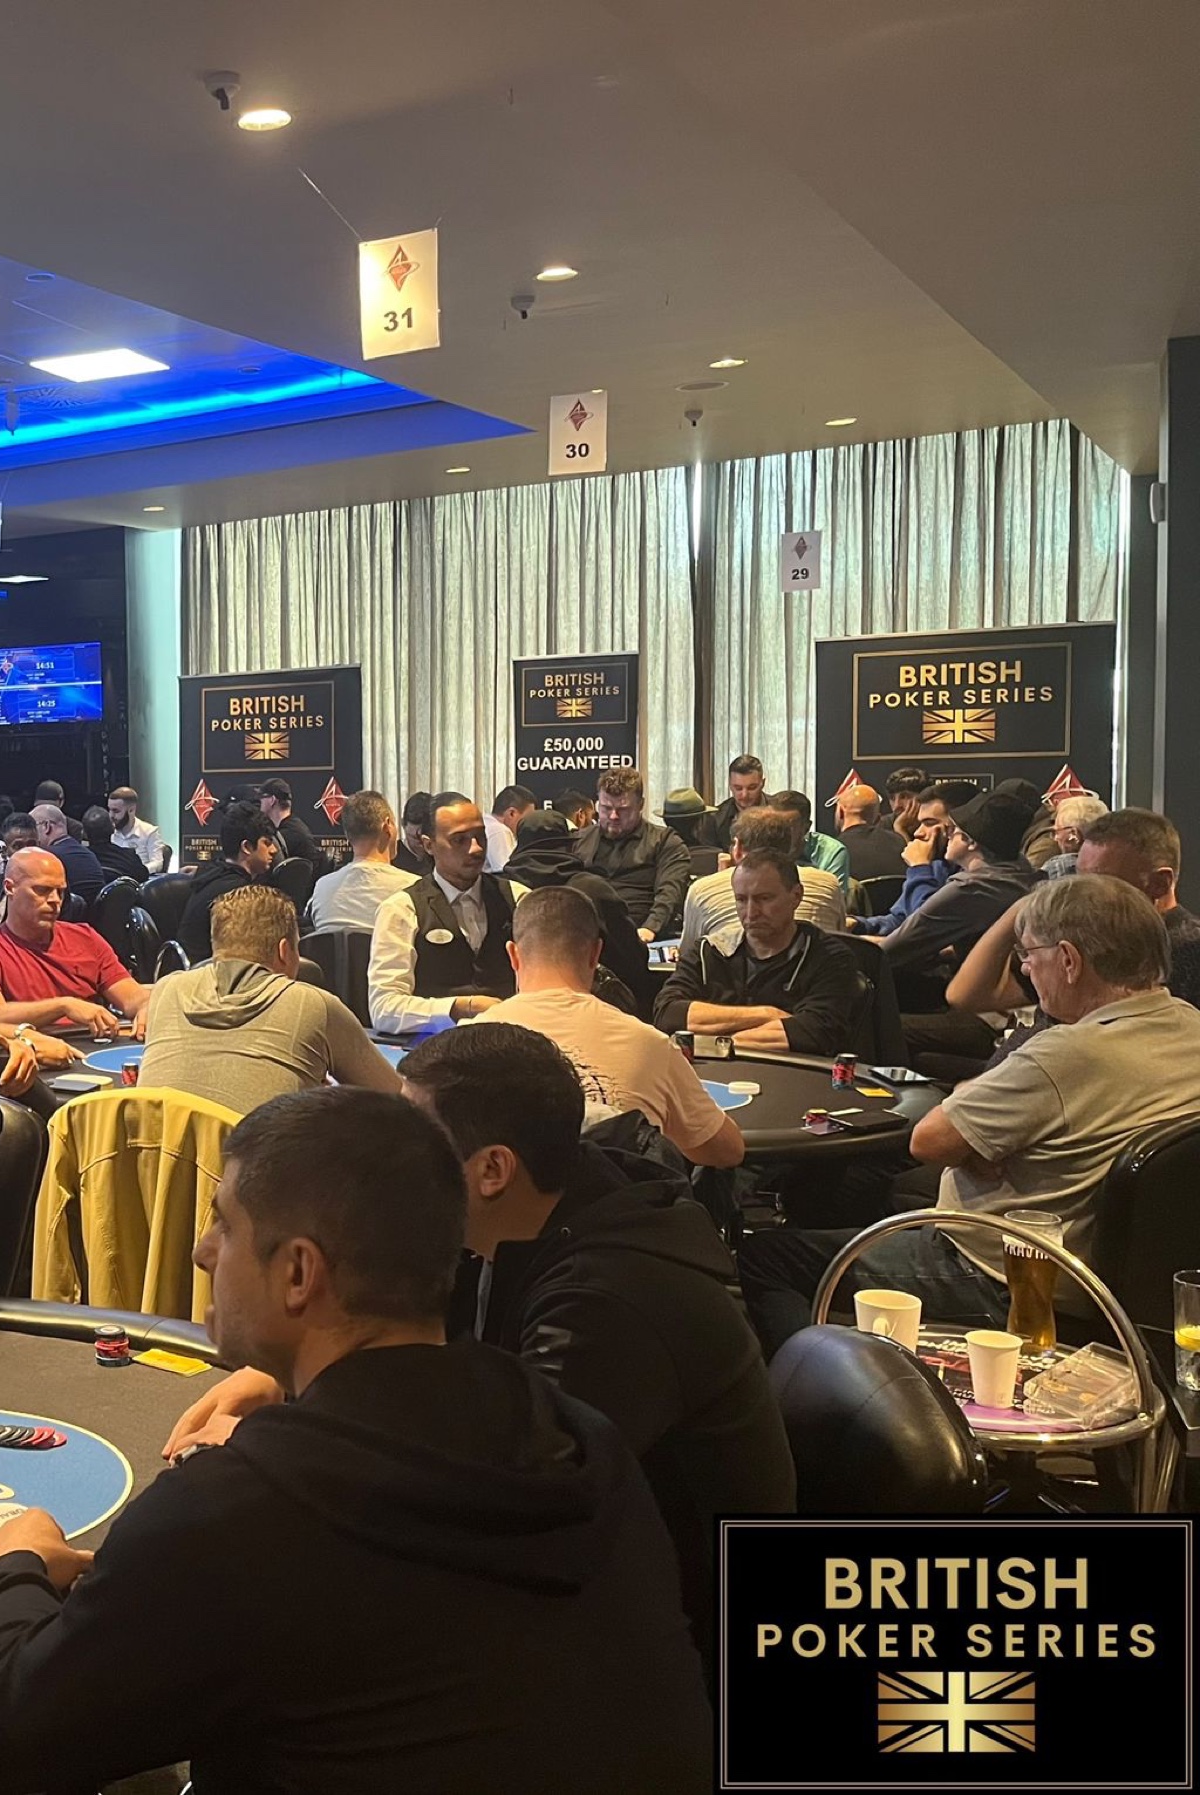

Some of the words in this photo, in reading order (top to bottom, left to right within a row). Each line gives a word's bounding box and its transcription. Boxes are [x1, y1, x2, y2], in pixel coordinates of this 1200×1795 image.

[383, 307, 413, 332] 31
[565, 443, 590, 459] 30
[791, 567, 810, 581] 29
[544, 672, 605, 687] BRITISH
[899, 660, 1022, 688] BRITISH
[529, 688, 571, 698] POKER
[575, 686, 620, 697] SERIES
[869, 687, 951, 708] POKER
[963, 686, 1053, 705] SERIES
[229, 694, 305, 716] BRITISH
[211, 717, 262, 732] POKER
[269, 715, 324, 729] SERIES
[543, 737, 604, 753] £50,000
[517, 754, 634, 771] GUARANTEED
